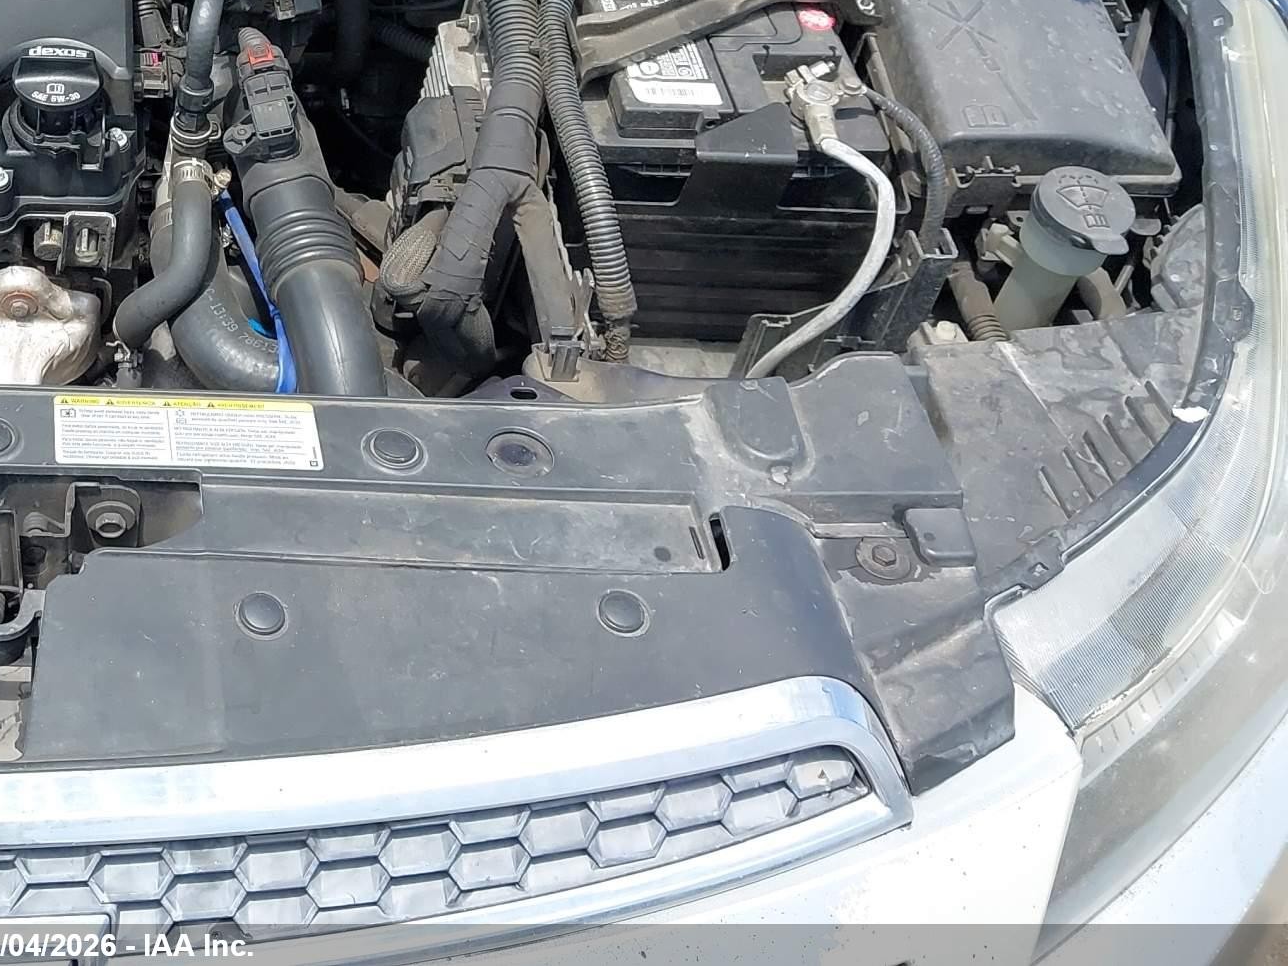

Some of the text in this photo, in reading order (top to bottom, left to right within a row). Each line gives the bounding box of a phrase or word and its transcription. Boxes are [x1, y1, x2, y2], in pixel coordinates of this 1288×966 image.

[28, 45, 88, 58] dexos
[31, 90, 81, 103] SAE 5W-30
